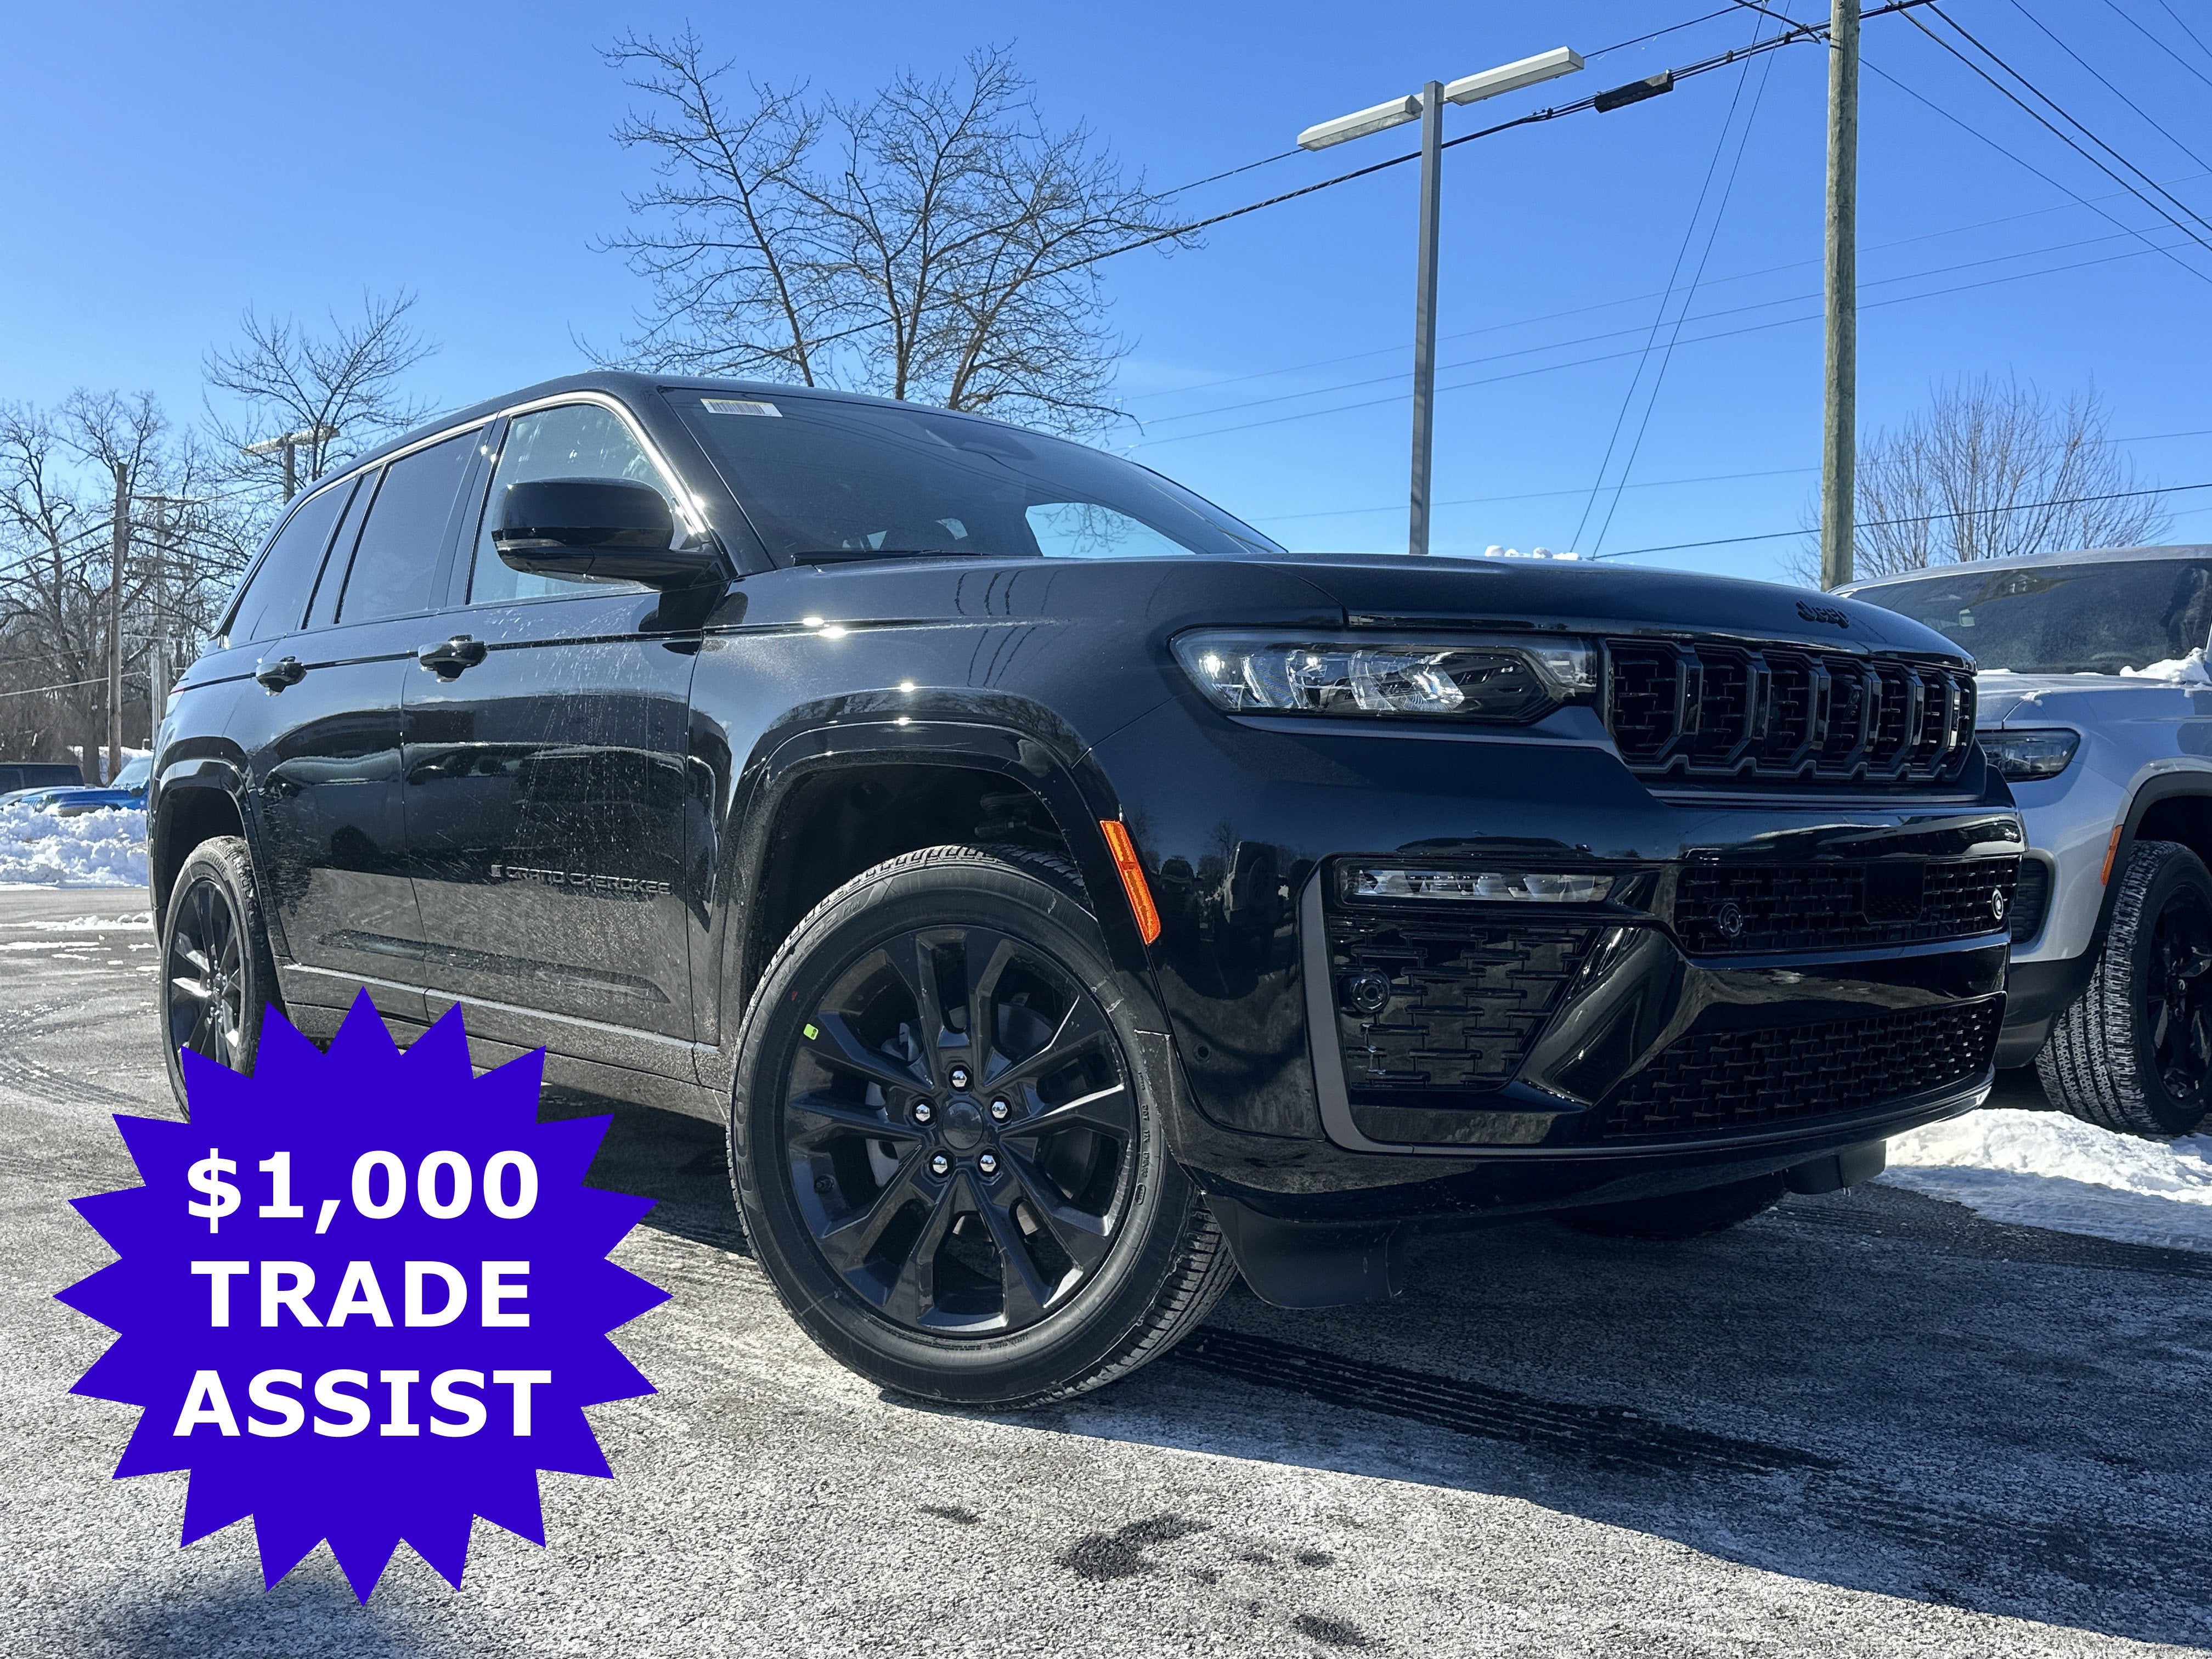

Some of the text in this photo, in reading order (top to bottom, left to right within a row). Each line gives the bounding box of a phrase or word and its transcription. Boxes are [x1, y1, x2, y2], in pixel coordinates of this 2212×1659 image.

[1796, 600, 1849, 629] Jeep
[506, 866, 672, 895] GRAND CHEROKEE
[843, 899, 861, 918] Plus
